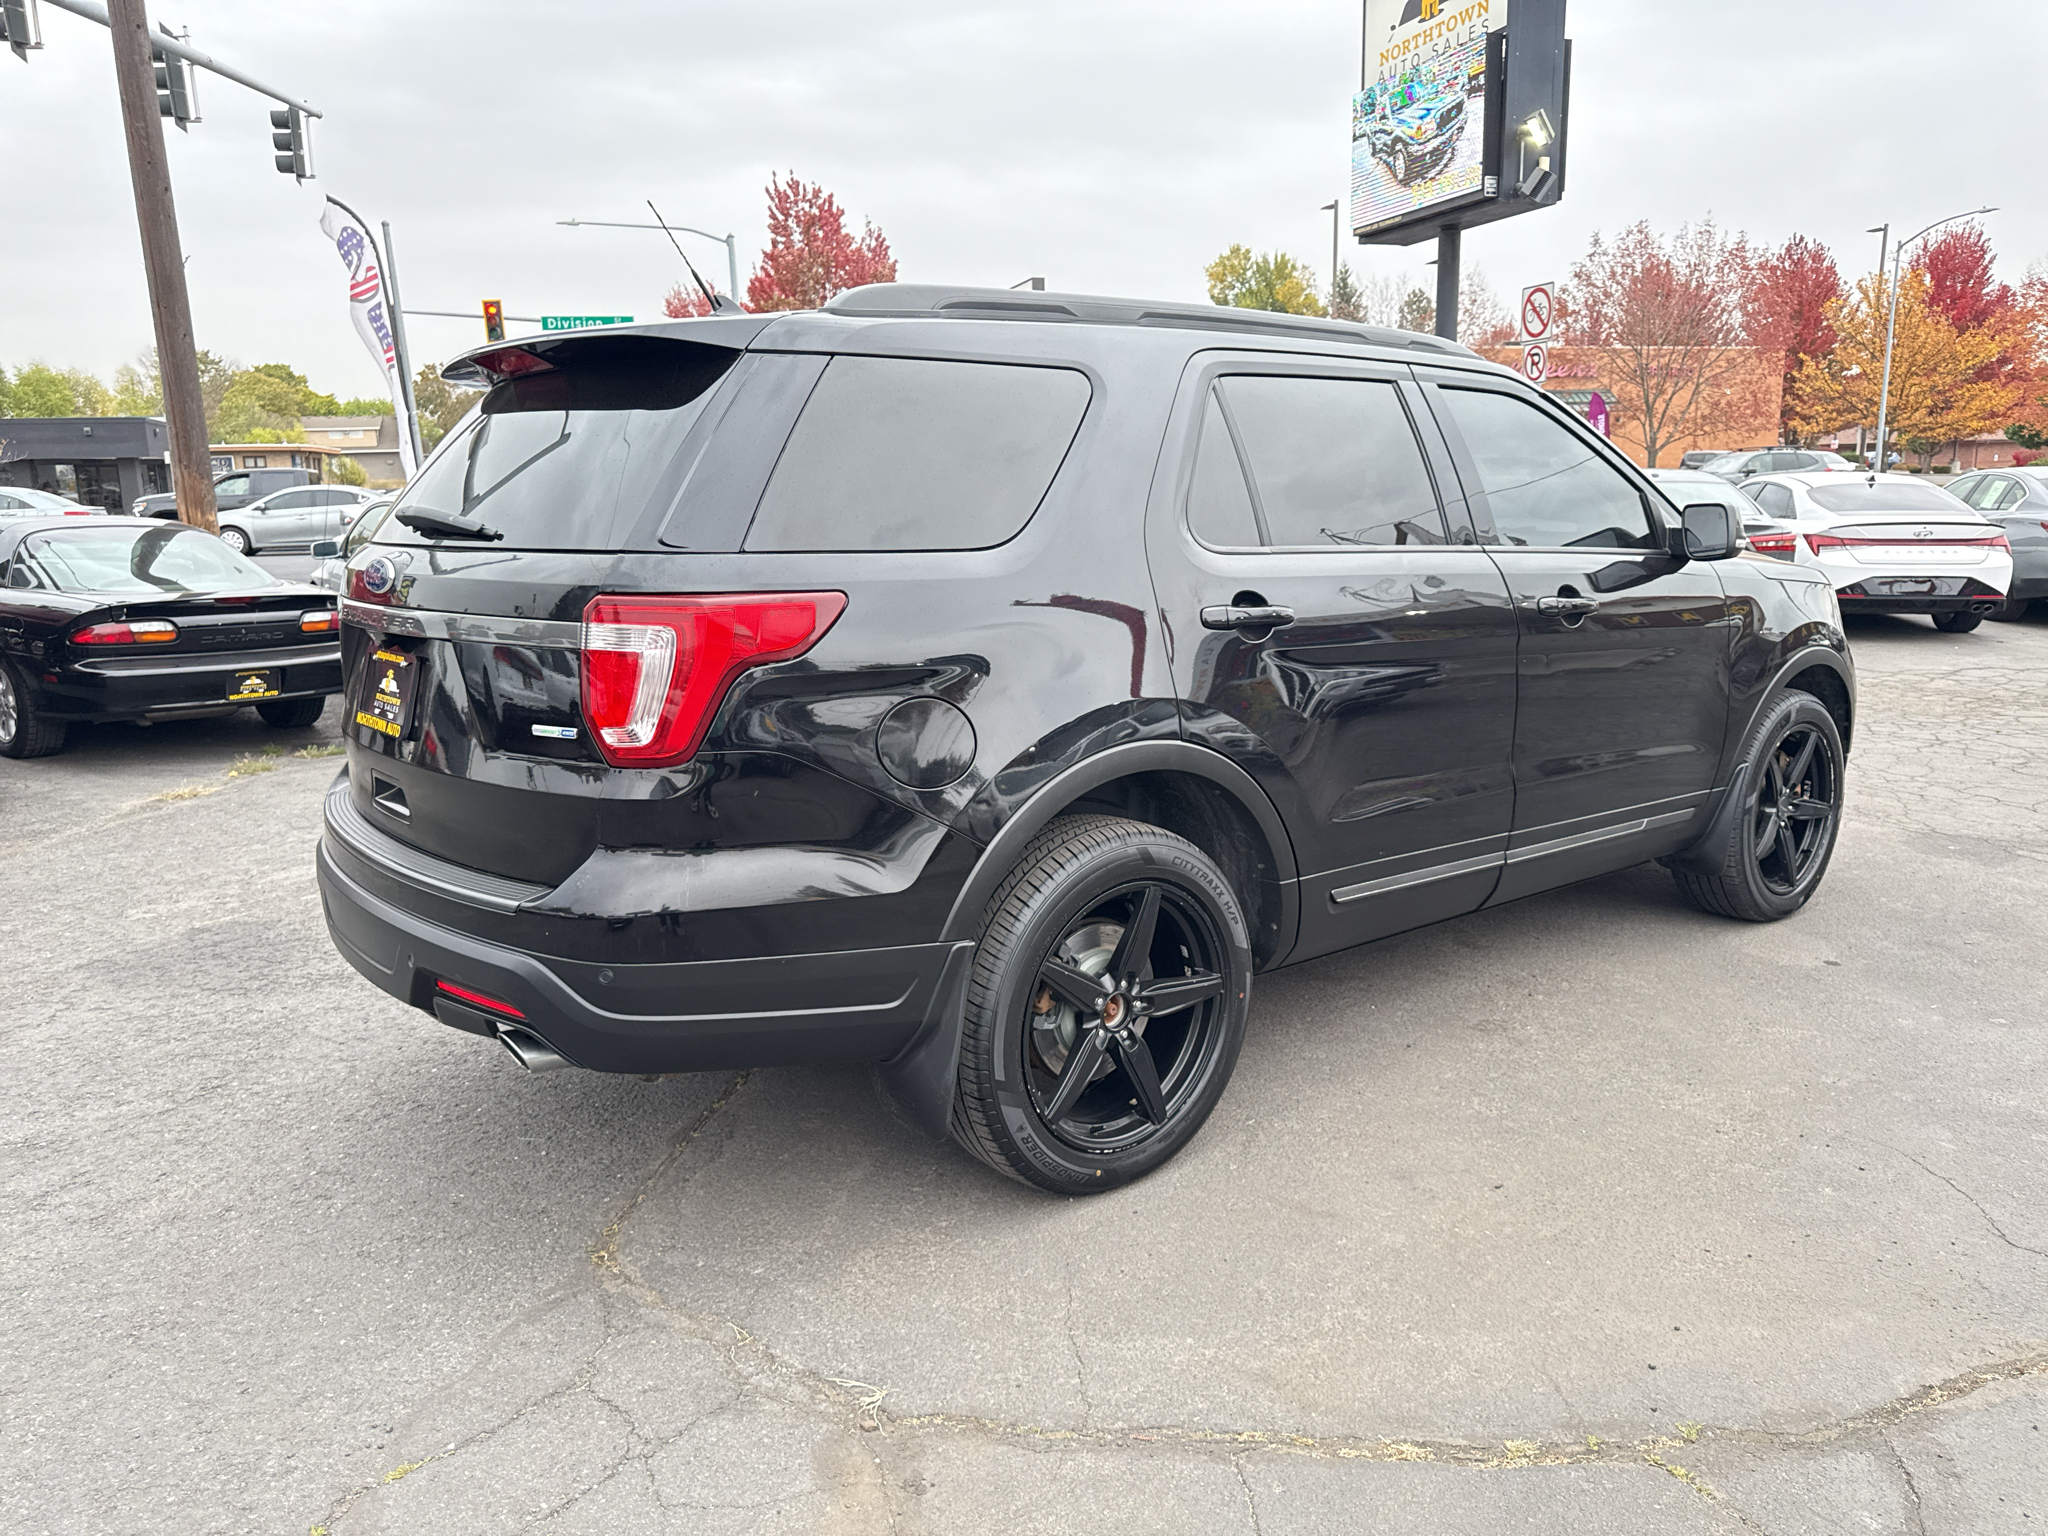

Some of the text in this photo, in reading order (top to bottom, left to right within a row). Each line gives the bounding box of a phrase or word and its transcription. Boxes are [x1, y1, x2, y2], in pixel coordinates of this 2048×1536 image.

[1379, 0, 1489, 67] NORTHTOWN
[1378, 18, 1489, 81] AUTO SALES
[547, 317, 603, 329] Division
[201, 631, 285, 644] CAMARO
[384, 703, 400, 713] SALES
[356, 711, 401, 738] NORTHTOWN AUTO
[1172, 855, 1239, 925] CITYTRAXX H/P
